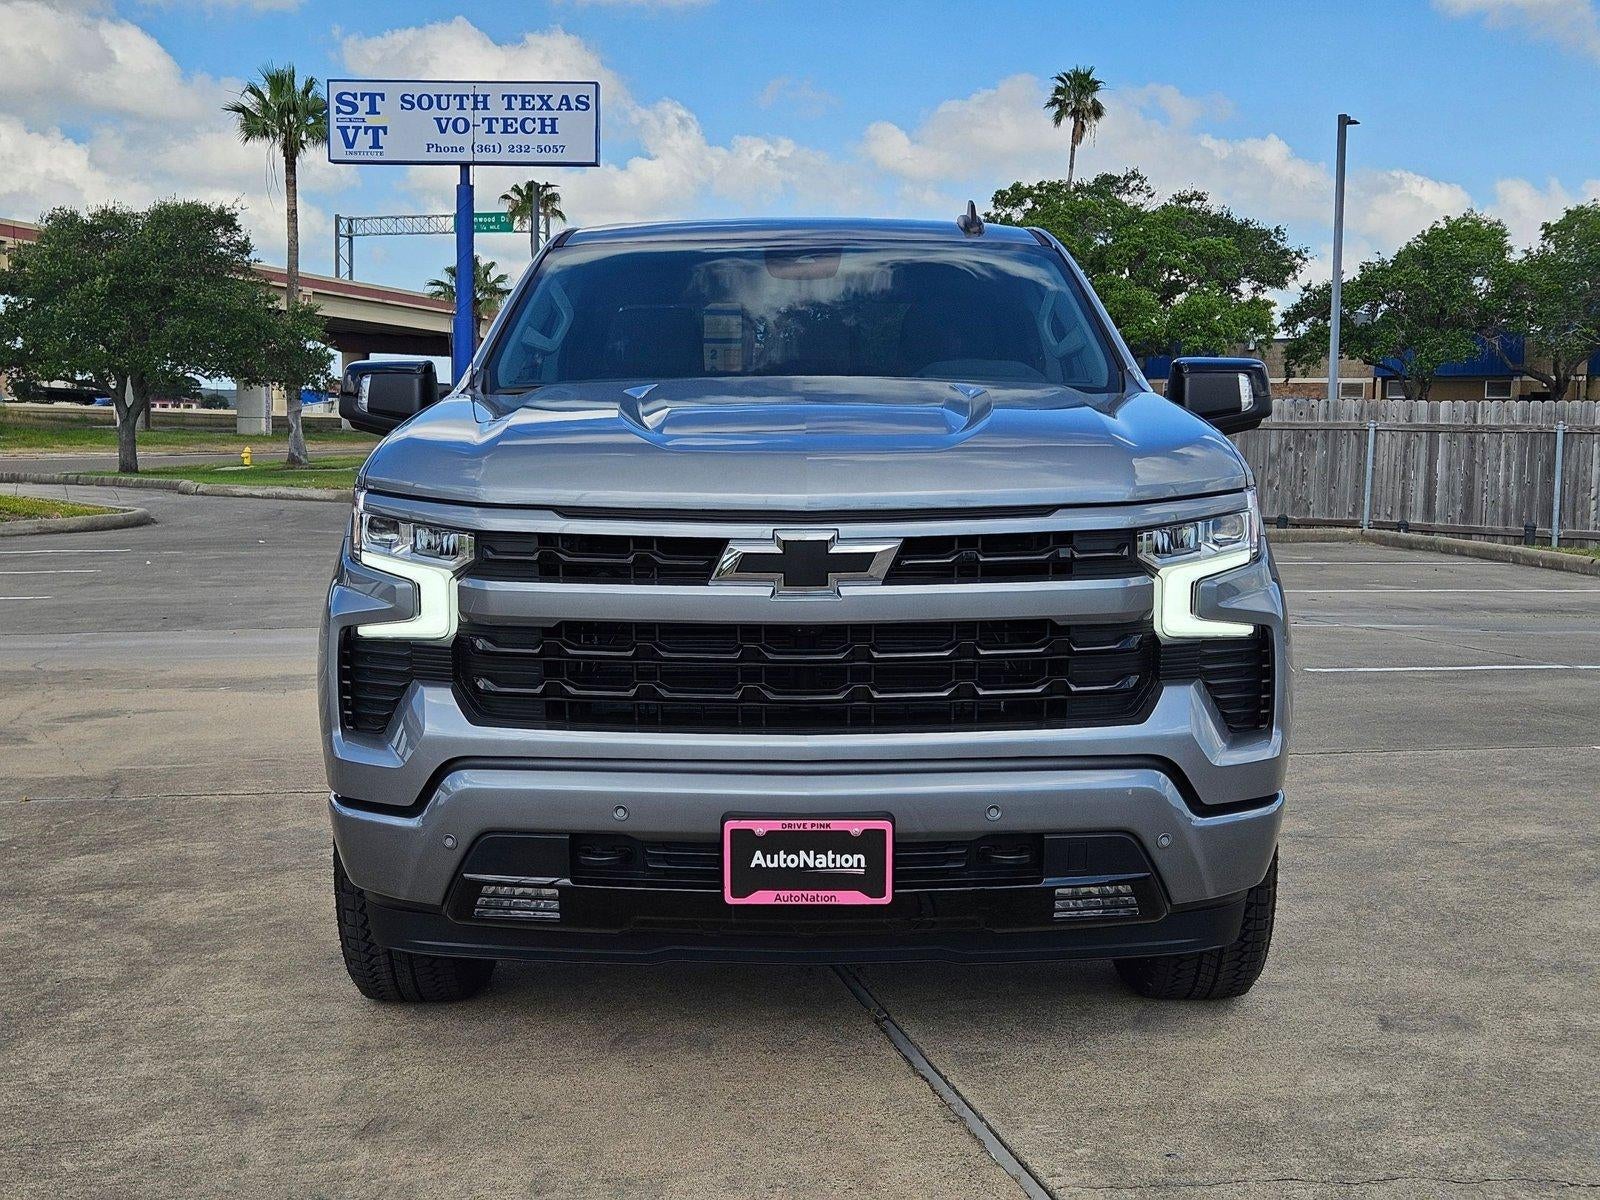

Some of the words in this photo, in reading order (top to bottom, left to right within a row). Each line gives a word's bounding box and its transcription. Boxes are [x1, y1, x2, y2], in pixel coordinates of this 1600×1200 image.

[335, 91, 385, 115] ST
[400, 94, 491, 111] SOUTH
[501, 94, 591, 112] TEXAS
[433, 117, 559, 135] VO-TECH
[336, 125, 388, 149] VT
[426, 143, 465, 153] Phone
[471, 142, 502, 154] (361)
[507, 144, 567, 154] 232-5057
[781, 822, 807, 830] DRIVE
[810, 822, 832, 830] PINK
[750, 850, 866, 869] AutoNation
[774, 893, 838, 903] AutoNation
